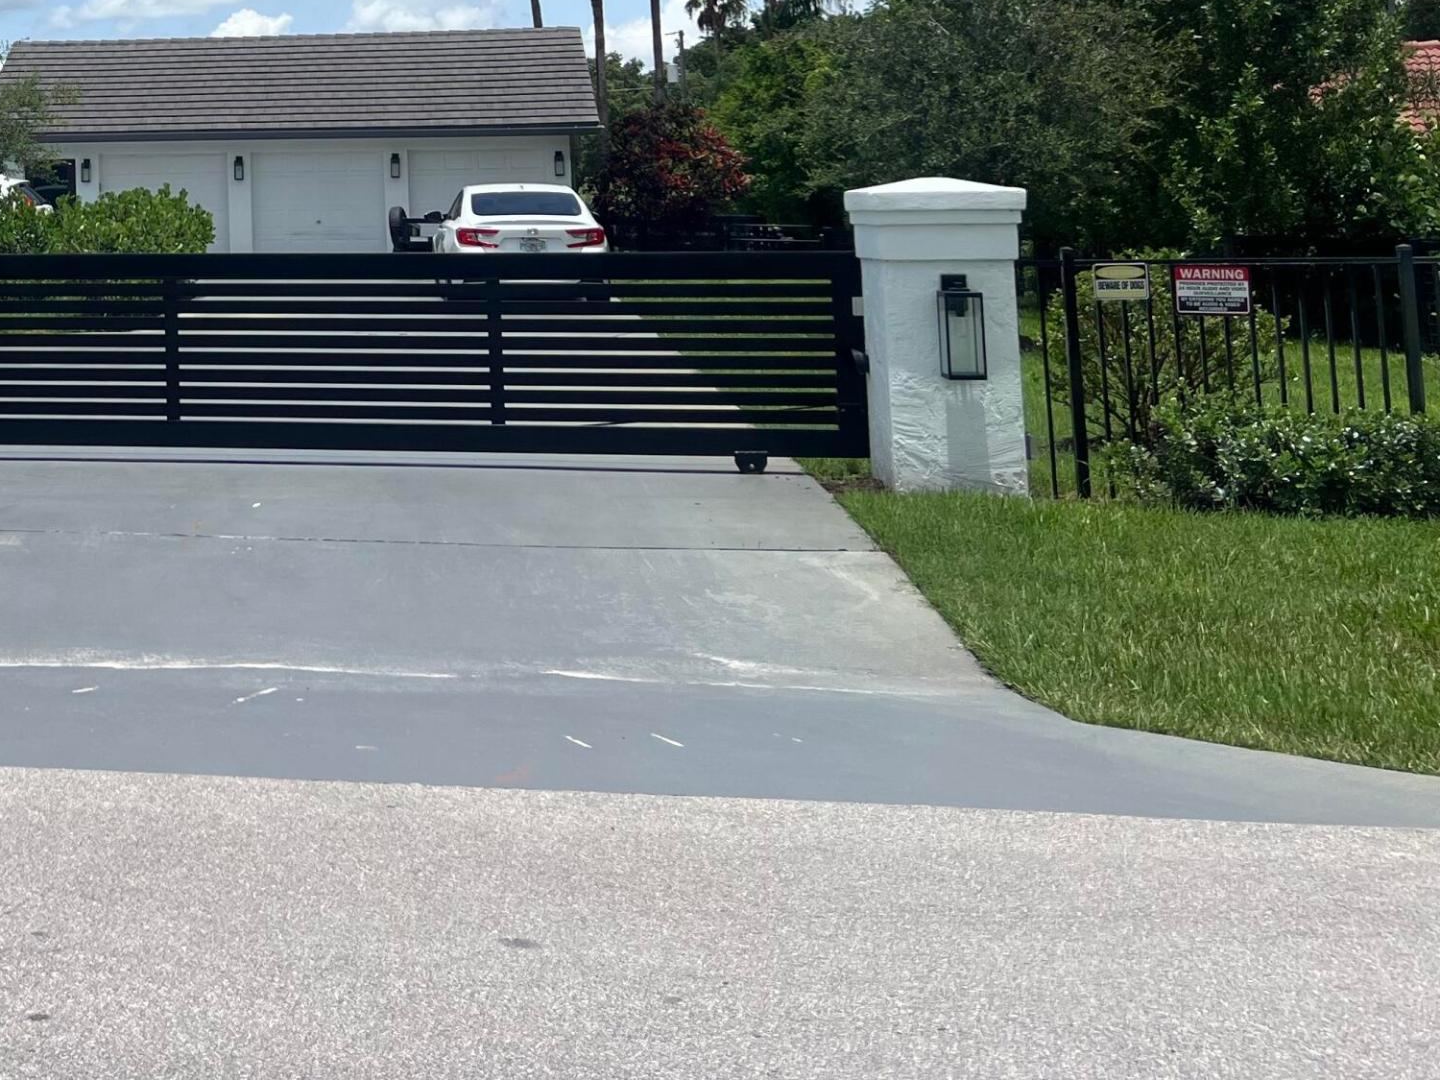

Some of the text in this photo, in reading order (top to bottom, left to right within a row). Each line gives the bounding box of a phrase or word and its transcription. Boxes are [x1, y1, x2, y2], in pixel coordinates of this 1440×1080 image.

[1179, 268, 1244, 280] WARNING
[1097, 281, 1120, 290] BEWARE
[1121, 281, 1129, 290] OF
